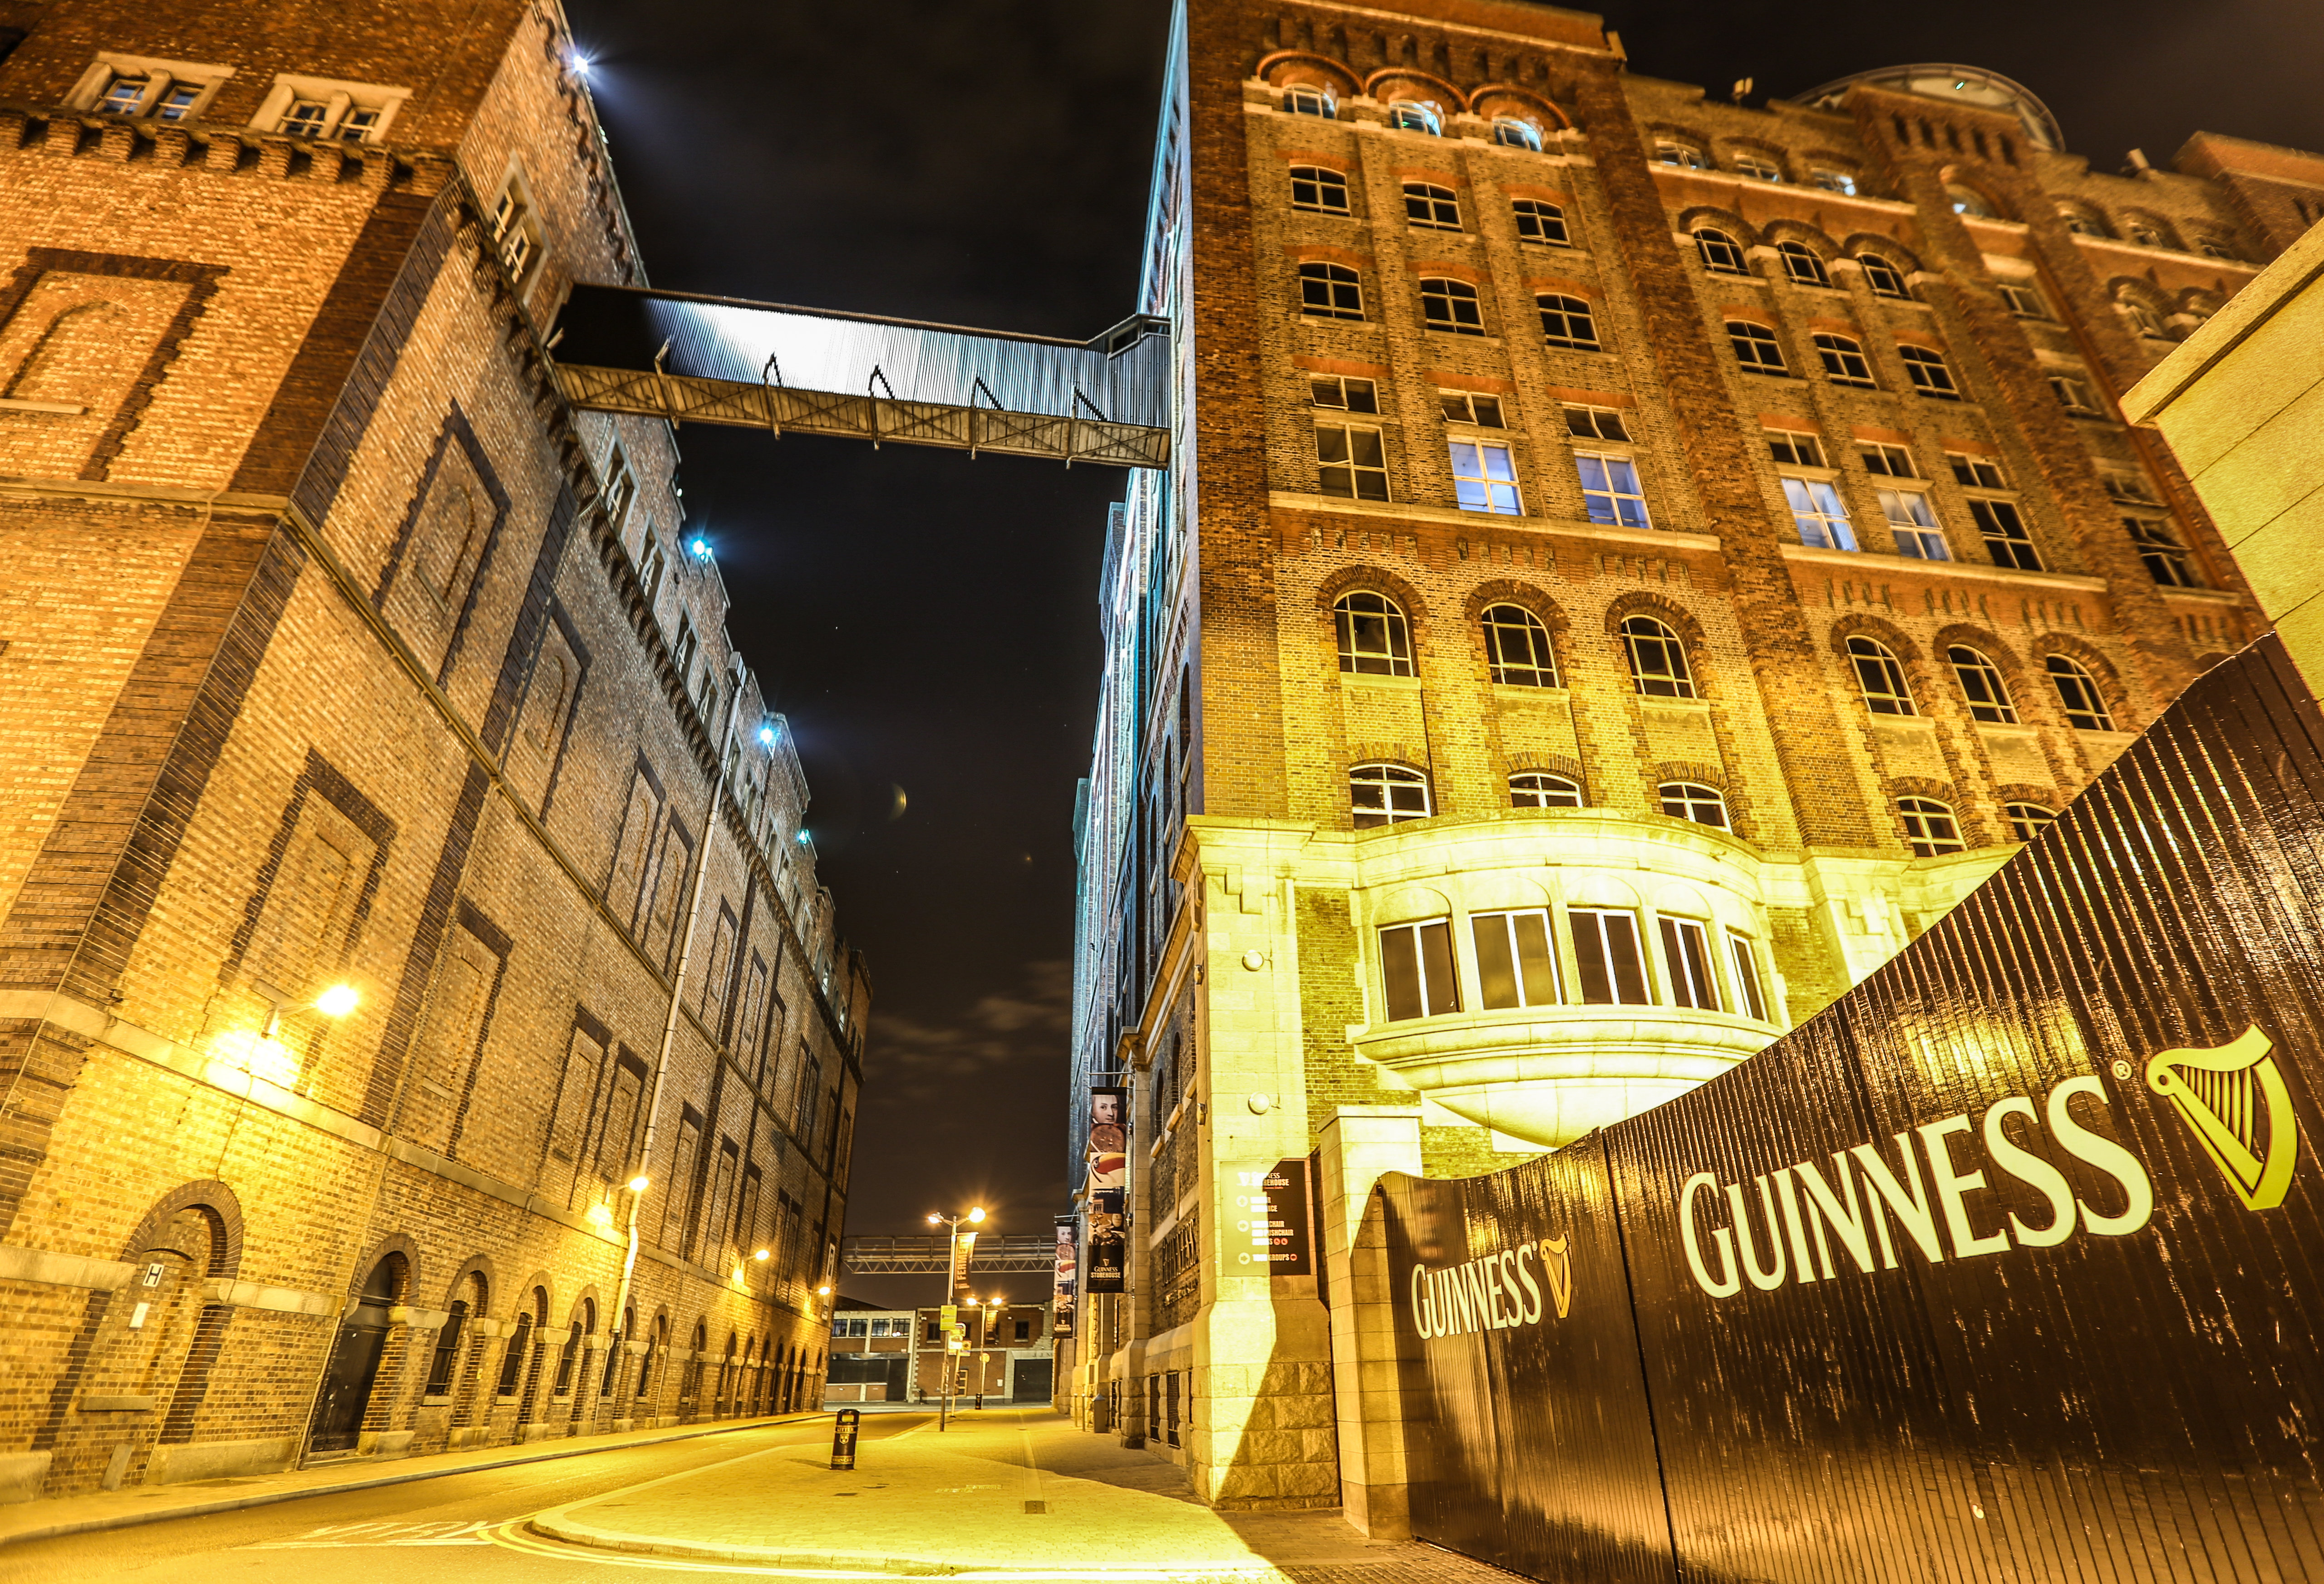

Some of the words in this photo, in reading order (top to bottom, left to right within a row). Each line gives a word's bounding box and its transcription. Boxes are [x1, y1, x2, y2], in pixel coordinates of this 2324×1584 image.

[1680, 1075, 2153, 1299] GUINNESS
[145, 1266, 162, 1285] H
[957, 1238, 970, 1280] FERMENT
[1411, 1244, 1542, 1340] GUINNESS
